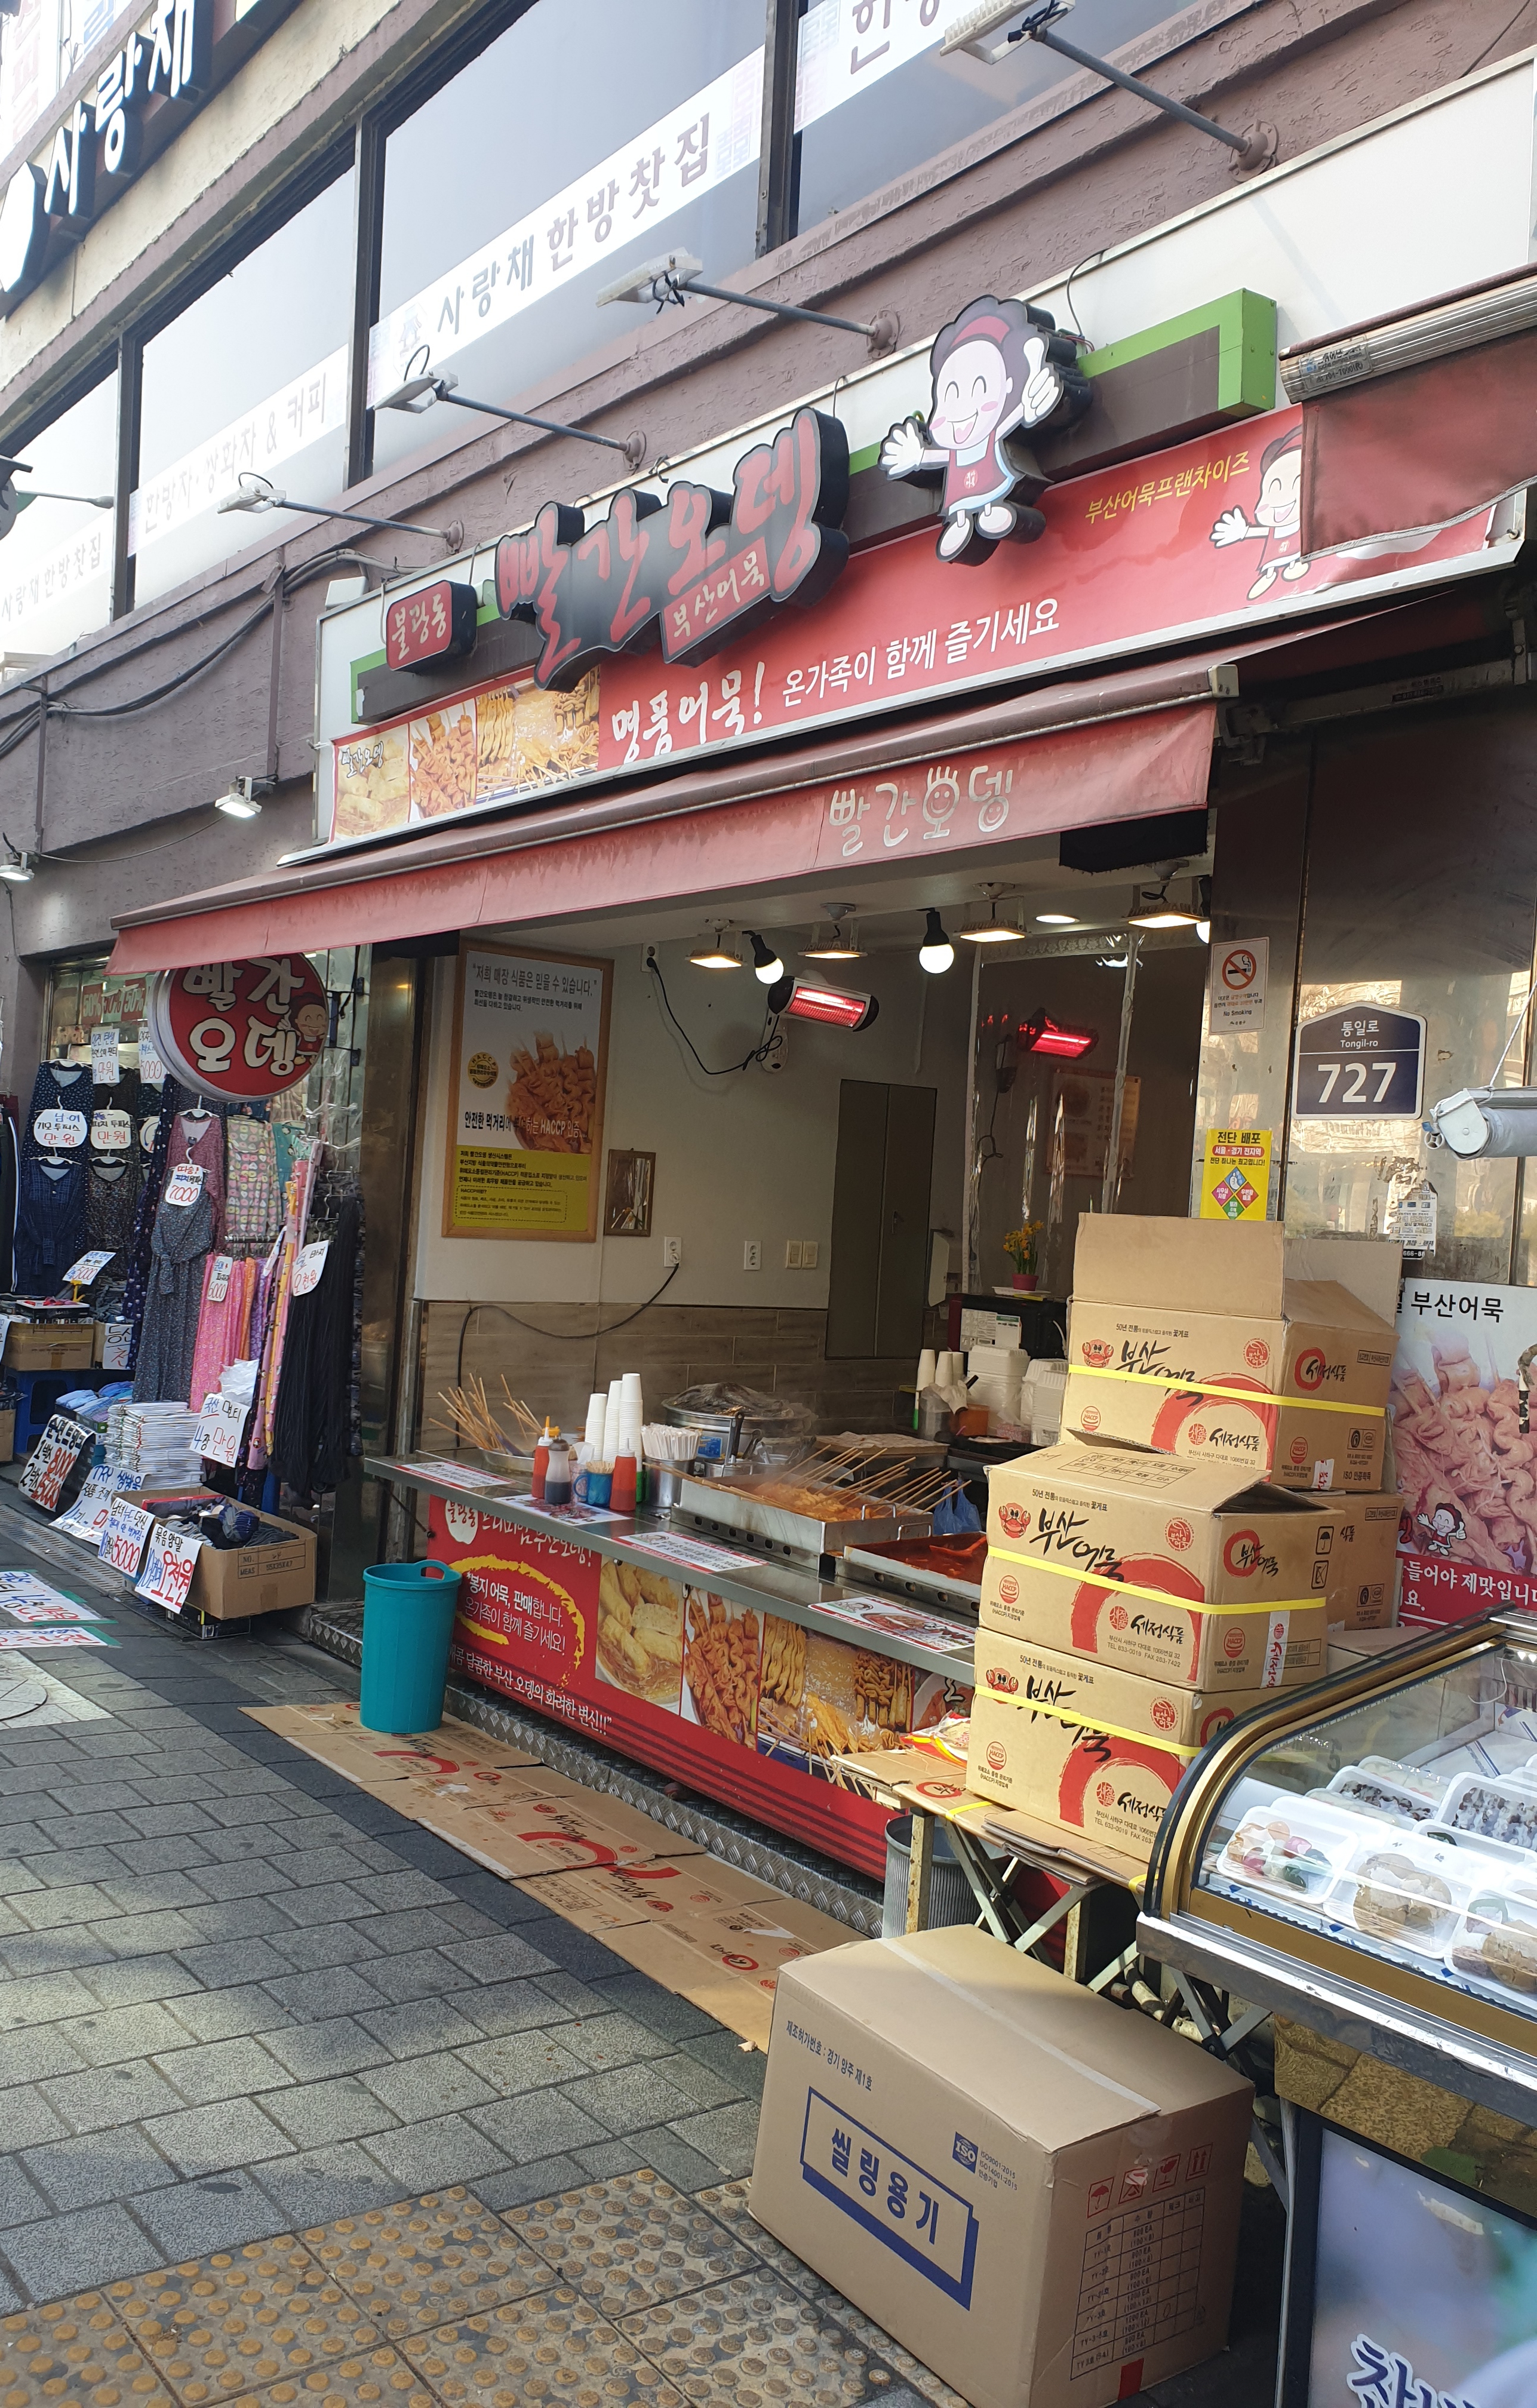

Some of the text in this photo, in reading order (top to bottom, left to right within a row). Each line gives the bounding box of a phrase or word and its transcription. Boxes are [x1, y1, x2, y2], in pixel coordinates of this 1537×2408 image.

[438, 112, 710, 334] 사랑채 한방찻집
[287, 372, 326, 438] 커피
[1086, 450, 1251, 524] 부산어묵프랜차이즈
[499, 416, 818, 683] 빨간오뎅
[44, 532, 101, 598] 한방찻집
[672, 552, 766, 638] 부산어묵
[391, 592, 448, 659] 불광동
[611, 597, 1059, 764] 명품어묵! 온가족이 함께 즐기세요
[342, 741, 384, 778] 빨간오뎅
[829, 764, 1013, 857] 빨간오뎅
[182, 957, 305, 1015] 빨간
[511, 969, 533, 988] 식품은
[536, 973, 550, 991] 믿을
[552, 975, 560, 992] 수
[84, 988, 143, 1017] 50% 50%
[1340, 1019, 1380, 1037] 통일로
[190, 1016, 300, 1076] 오뎅
[1340, 1039, 1379, 1049] Tongil-ro
[98, 1061, 116, 1082] 만원
[140, 1059, 163, 1081] 5000
[1317, 1062, 1397, 1104] 727
[36, 1122, 81, 1132] 기모 투피스
[97, 1130, 127, 1144] 만원
[465, 1111, 484, 1130] 안전한
[540, 1119, 565, 1135] HACCP
[1217, 1132, 1261, 1144] 전단 배포
[1244, 1147, 1262, 1156] 전지역
[309, 1246, 325, 1259] 바지
[207, 1281, 226, 1300] 6000
[294, 1269, 318, 1294] 오천원
[1410, 1290, 1504, 1323] 부산어묵
[1115, 1323, 1127, 1332] 50년
[204, 1396, 242, 1423] 국산 면티
[212, 1427, 236, 1464] 만원
[1209, 1427, 1261, 1451] 세정식품
[1344, 1471, 1352, 1479] ISO
[1032, 1489, 1044, 1498] 50년
[1091, 1501, 1108, 1511] 꽃게표
[110, 1534, 140, 1573] 5000
[155, 1526, 184, 1553] 묶음 양말
[1029, 1507, 1125, 1583] 부산어묵
[240, 1567, 255, 1575] MEAS
[1403, 1560, 1458, 1592] 들어야
[1002, 1583, 1017, 1592] HACCP
[513, 1590, 564, 1628] 판매합니다.
[465, 1596, 565, 1657] 온가족이 함께 즐기세요!
[1109, 1634, 1122, 1644] 부산시
[1130, 1614, 1185, 1645] 세정식품
[1019, 1655, 1031, 1665] 50년
[1077, 1672, 1095, 1684] 꽃게표
[466, 1651, 493, 1680] 달콤한
[494, 1664, 514, 1691] 부산
[514, 1676, 543, 1706] 오뎅의
[545, 1689, 576, 1720] 화려한
[989, 1749, 1004, 1759] HACCP
[1095, 1817, 1103, 1826] TEL
[1130, 1830, 1141, 1840] FAX
[1096, 1810, 1109, 1820] 부산시
[786, 2020, 872, 2091] 제조허가번호 경기 양주 제1호
[955, 2140, 976, 2163] ISO
[980, 2150, 1016, 2179] ISO9001:2015
[831, 2126, 941, 2247] 씰링용기
[979, 2159, 1018, 2191] ISO14001:2015
